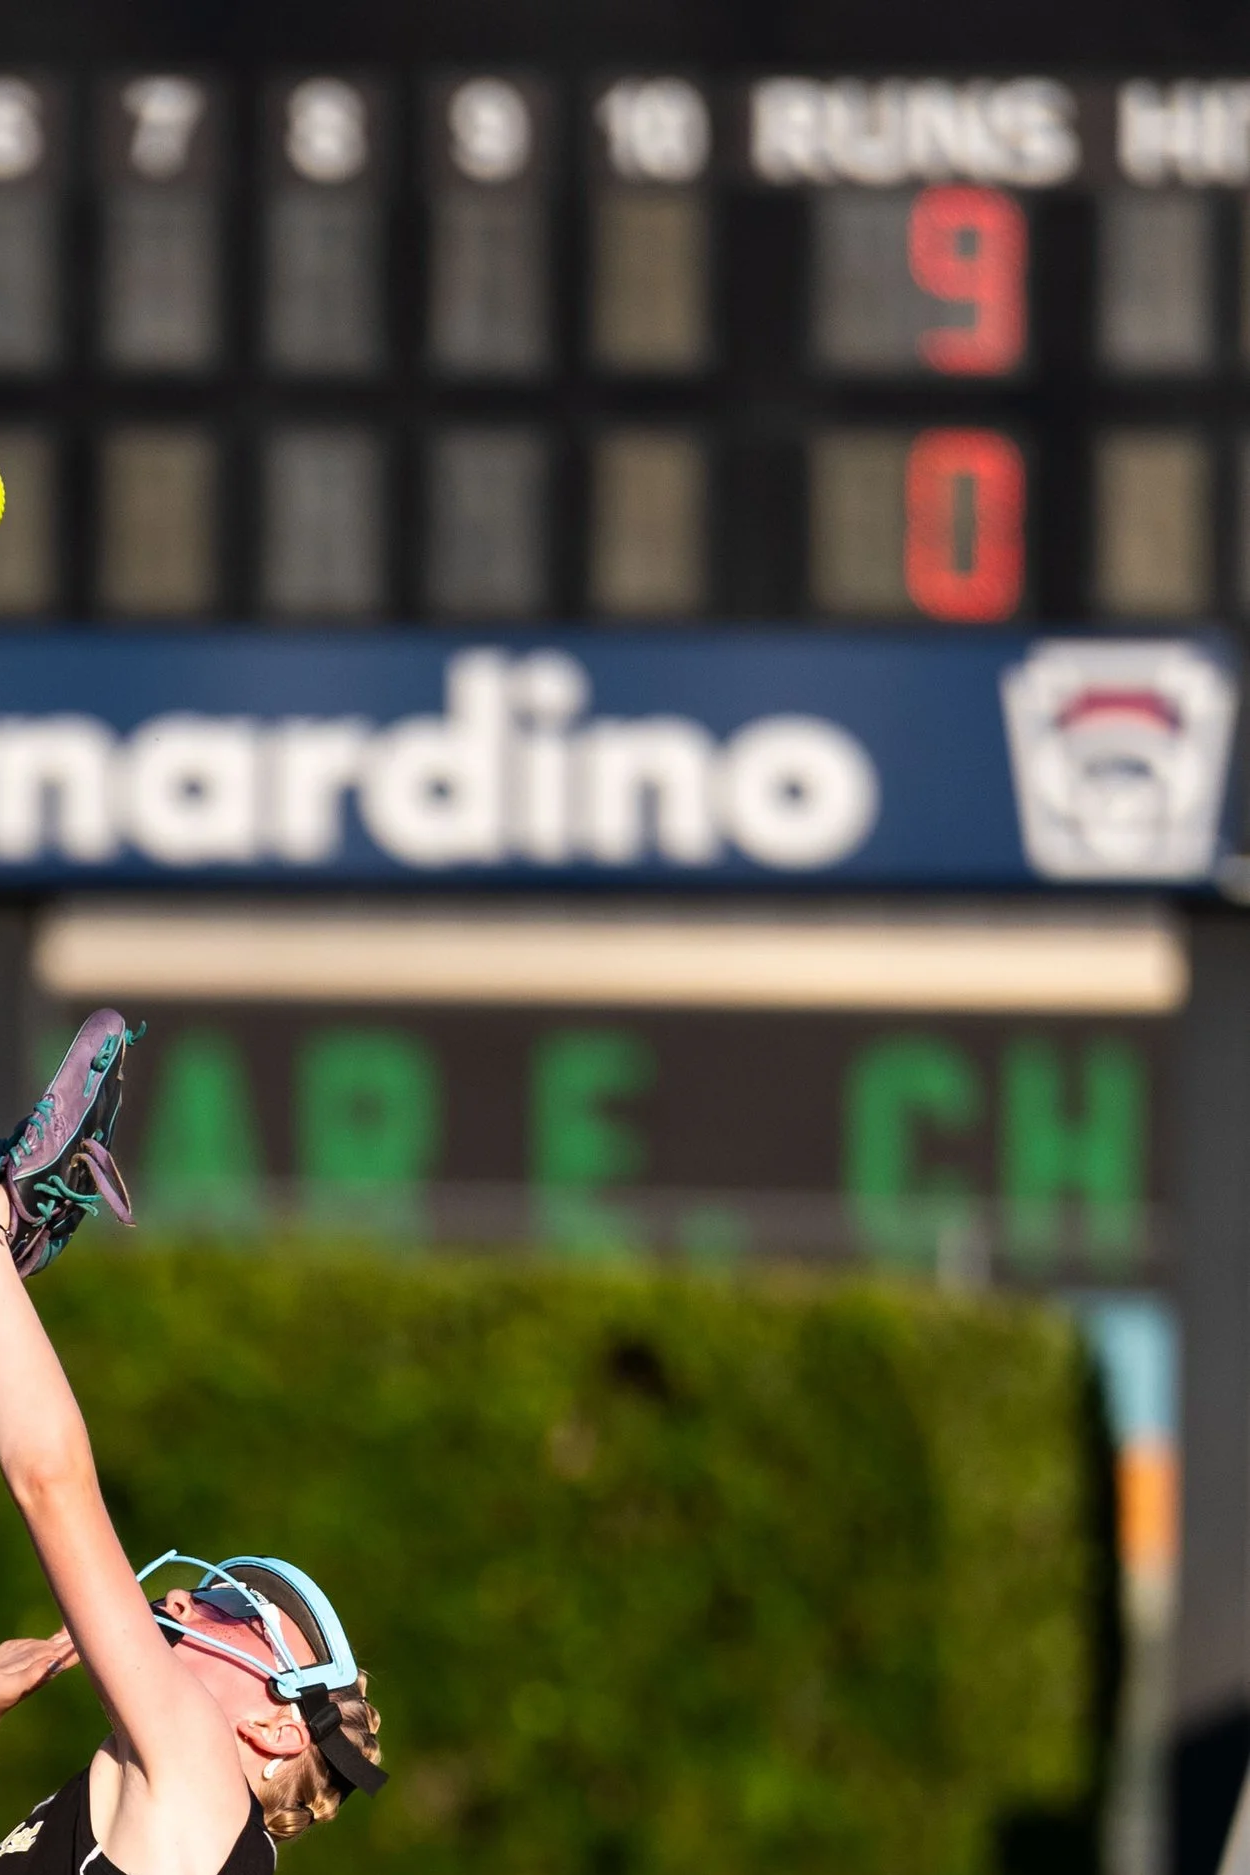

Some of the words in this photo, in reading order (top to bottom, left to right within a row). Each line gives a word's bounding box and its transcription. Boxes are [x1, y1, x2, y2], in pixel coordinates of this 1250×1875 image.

[125, 76, 202, 178] 7
[287, 78, 365, 181] 8
[451, 79, 530, 181] 9
[600, 78, 707, 181] 10
[751, 78, 1080, 186] RUNS
[1115, 80, 1250, 184] HI
[907, 184, 1027, 375] 9
[904, 428, 1026, 623] 0
